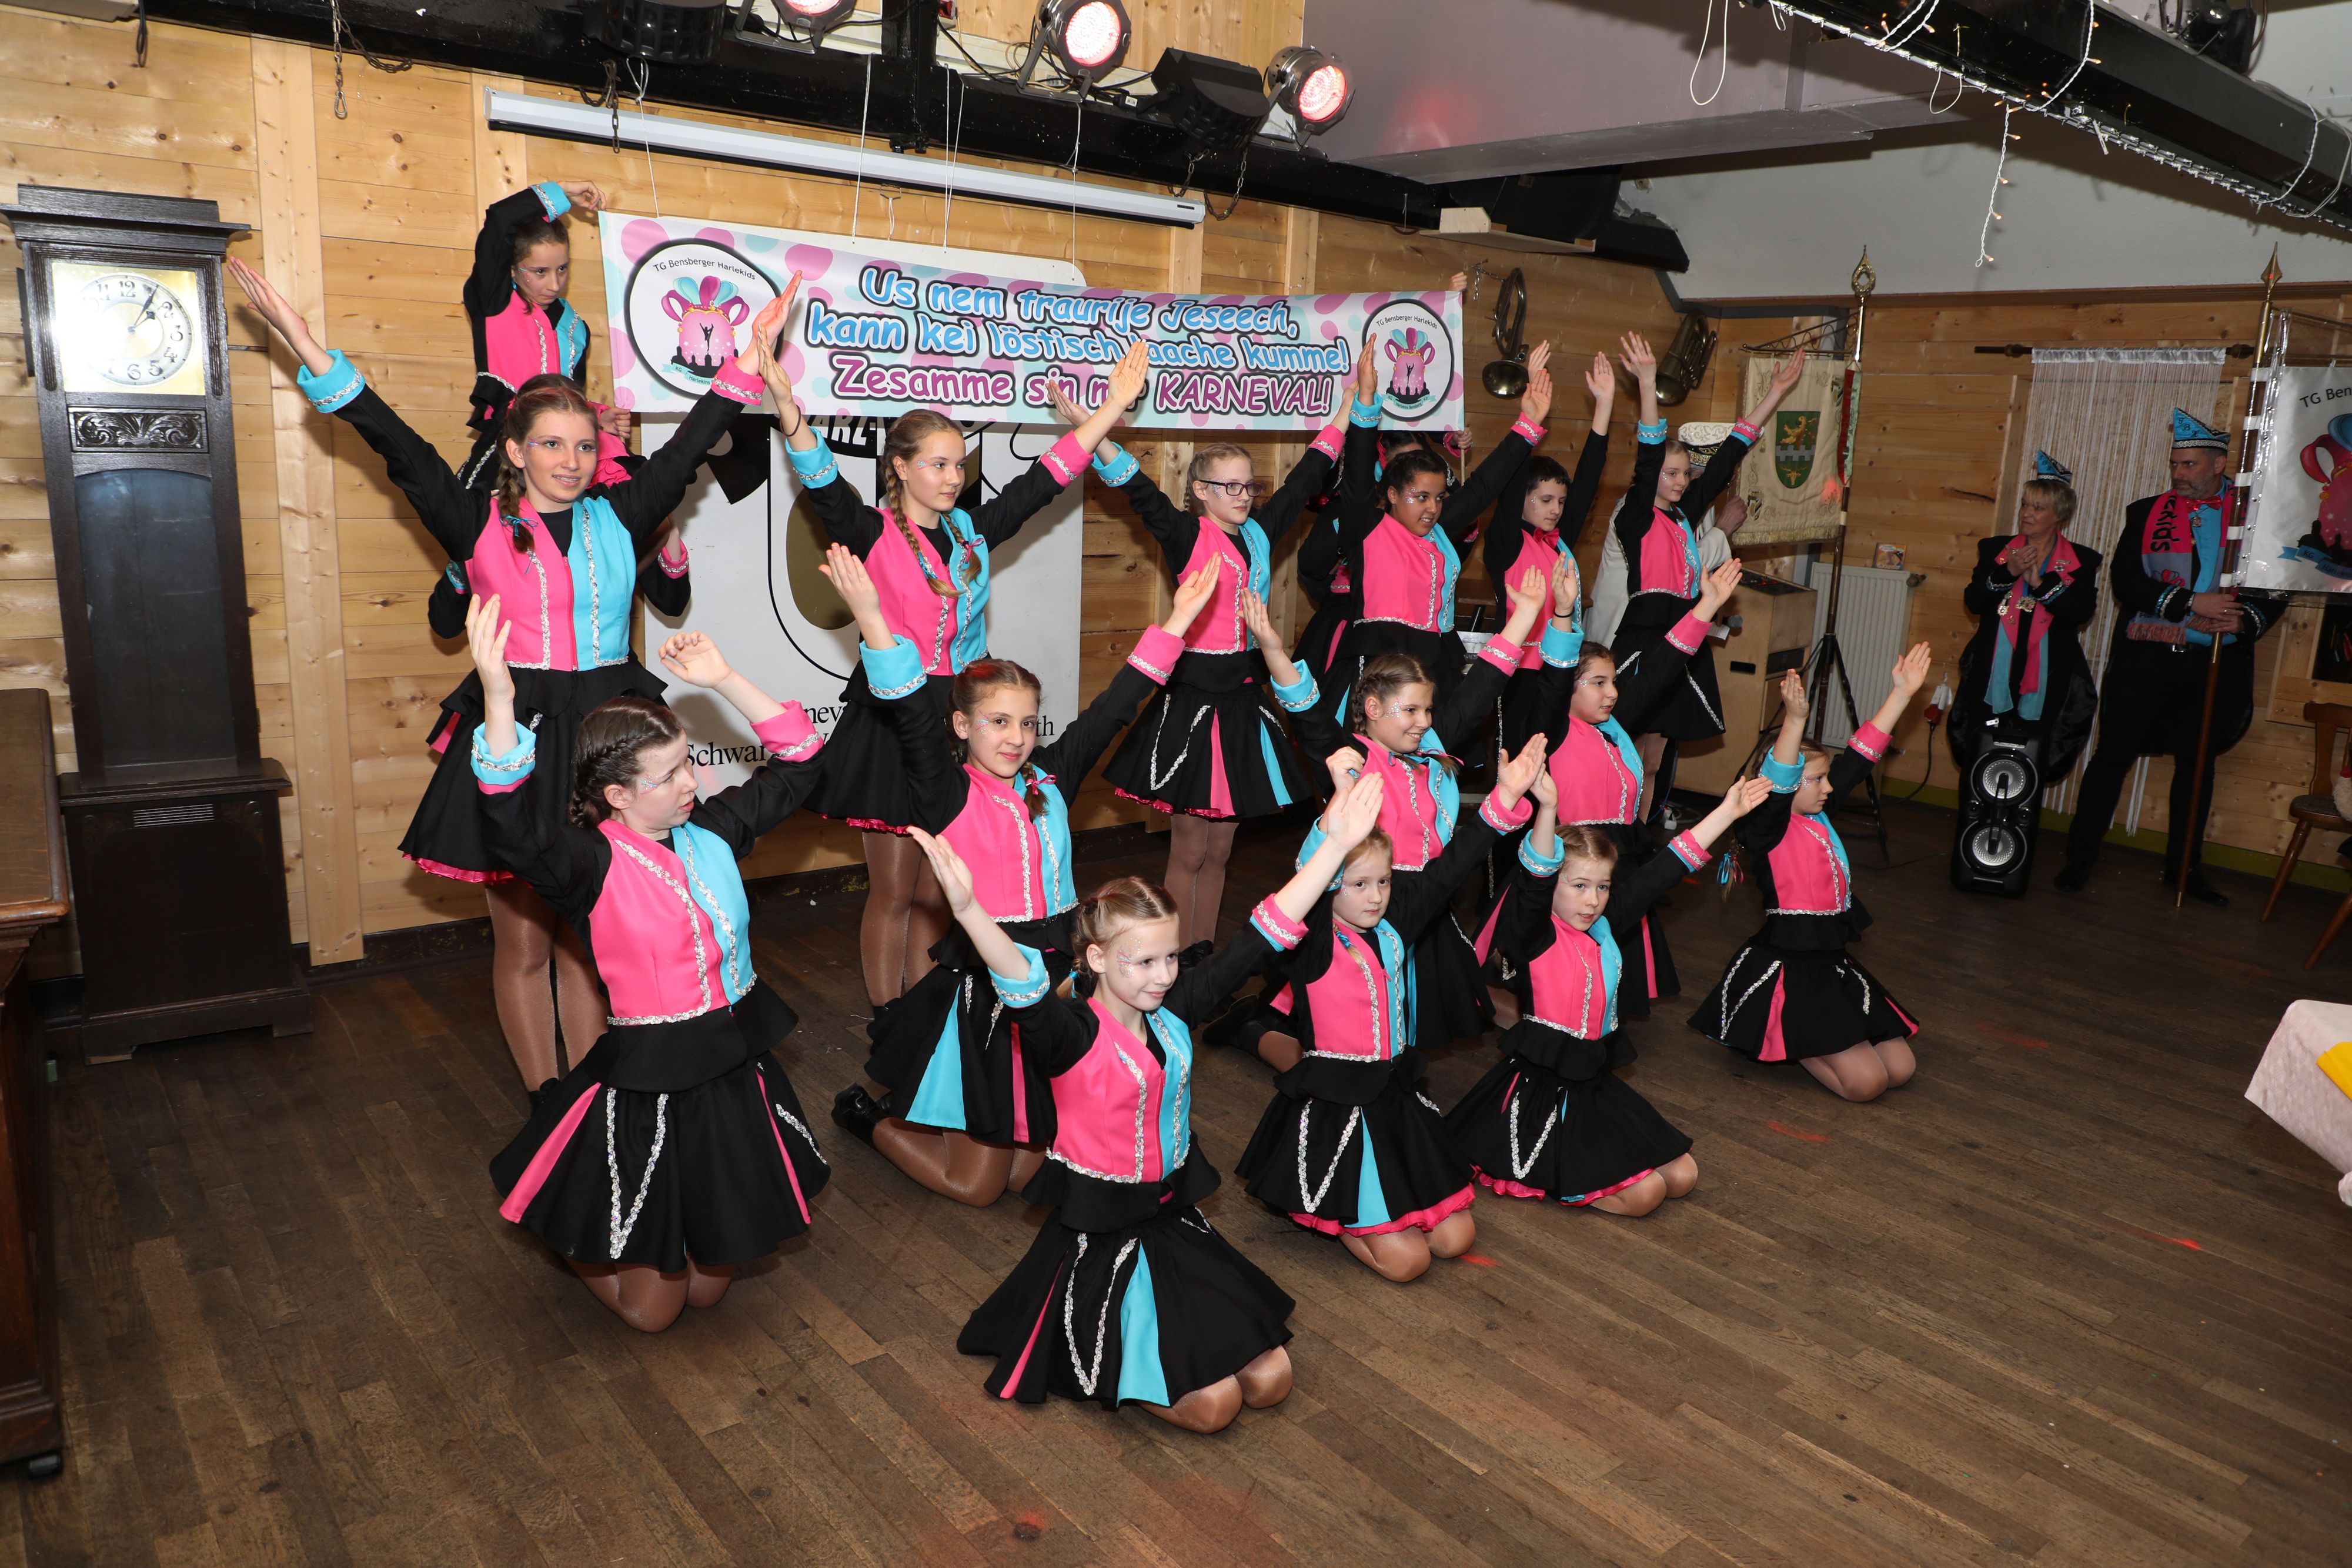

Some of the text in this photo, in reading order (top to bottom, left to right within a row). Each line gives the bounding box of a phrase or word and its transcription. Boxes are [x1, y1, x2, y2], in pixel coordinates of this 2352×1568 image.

[653, 258, 756, 280] TG Bensberger Harlekids
[119, 280, 136, 297] 12
[864, 269, 1296, 337] Us nem traurije Jeseech,
[1384, 315, 1413, 323] Bensberger
[170, 325, 183, 342] 3
[808, 302, 904, 350] kann
[919, 315, 975, 353] kei
[986, 322, 1124, 361] löstisch
[1241, 337, 1348, 372] kumme!
[127, 363, 141, 380] 6
[148, 360, 163, 376] 5
[833, 356, 1013, 403] Zesamme
[1160, 374, 1330, 413] KARNEVAL!
[2300, 392, 2321, 407] TG
